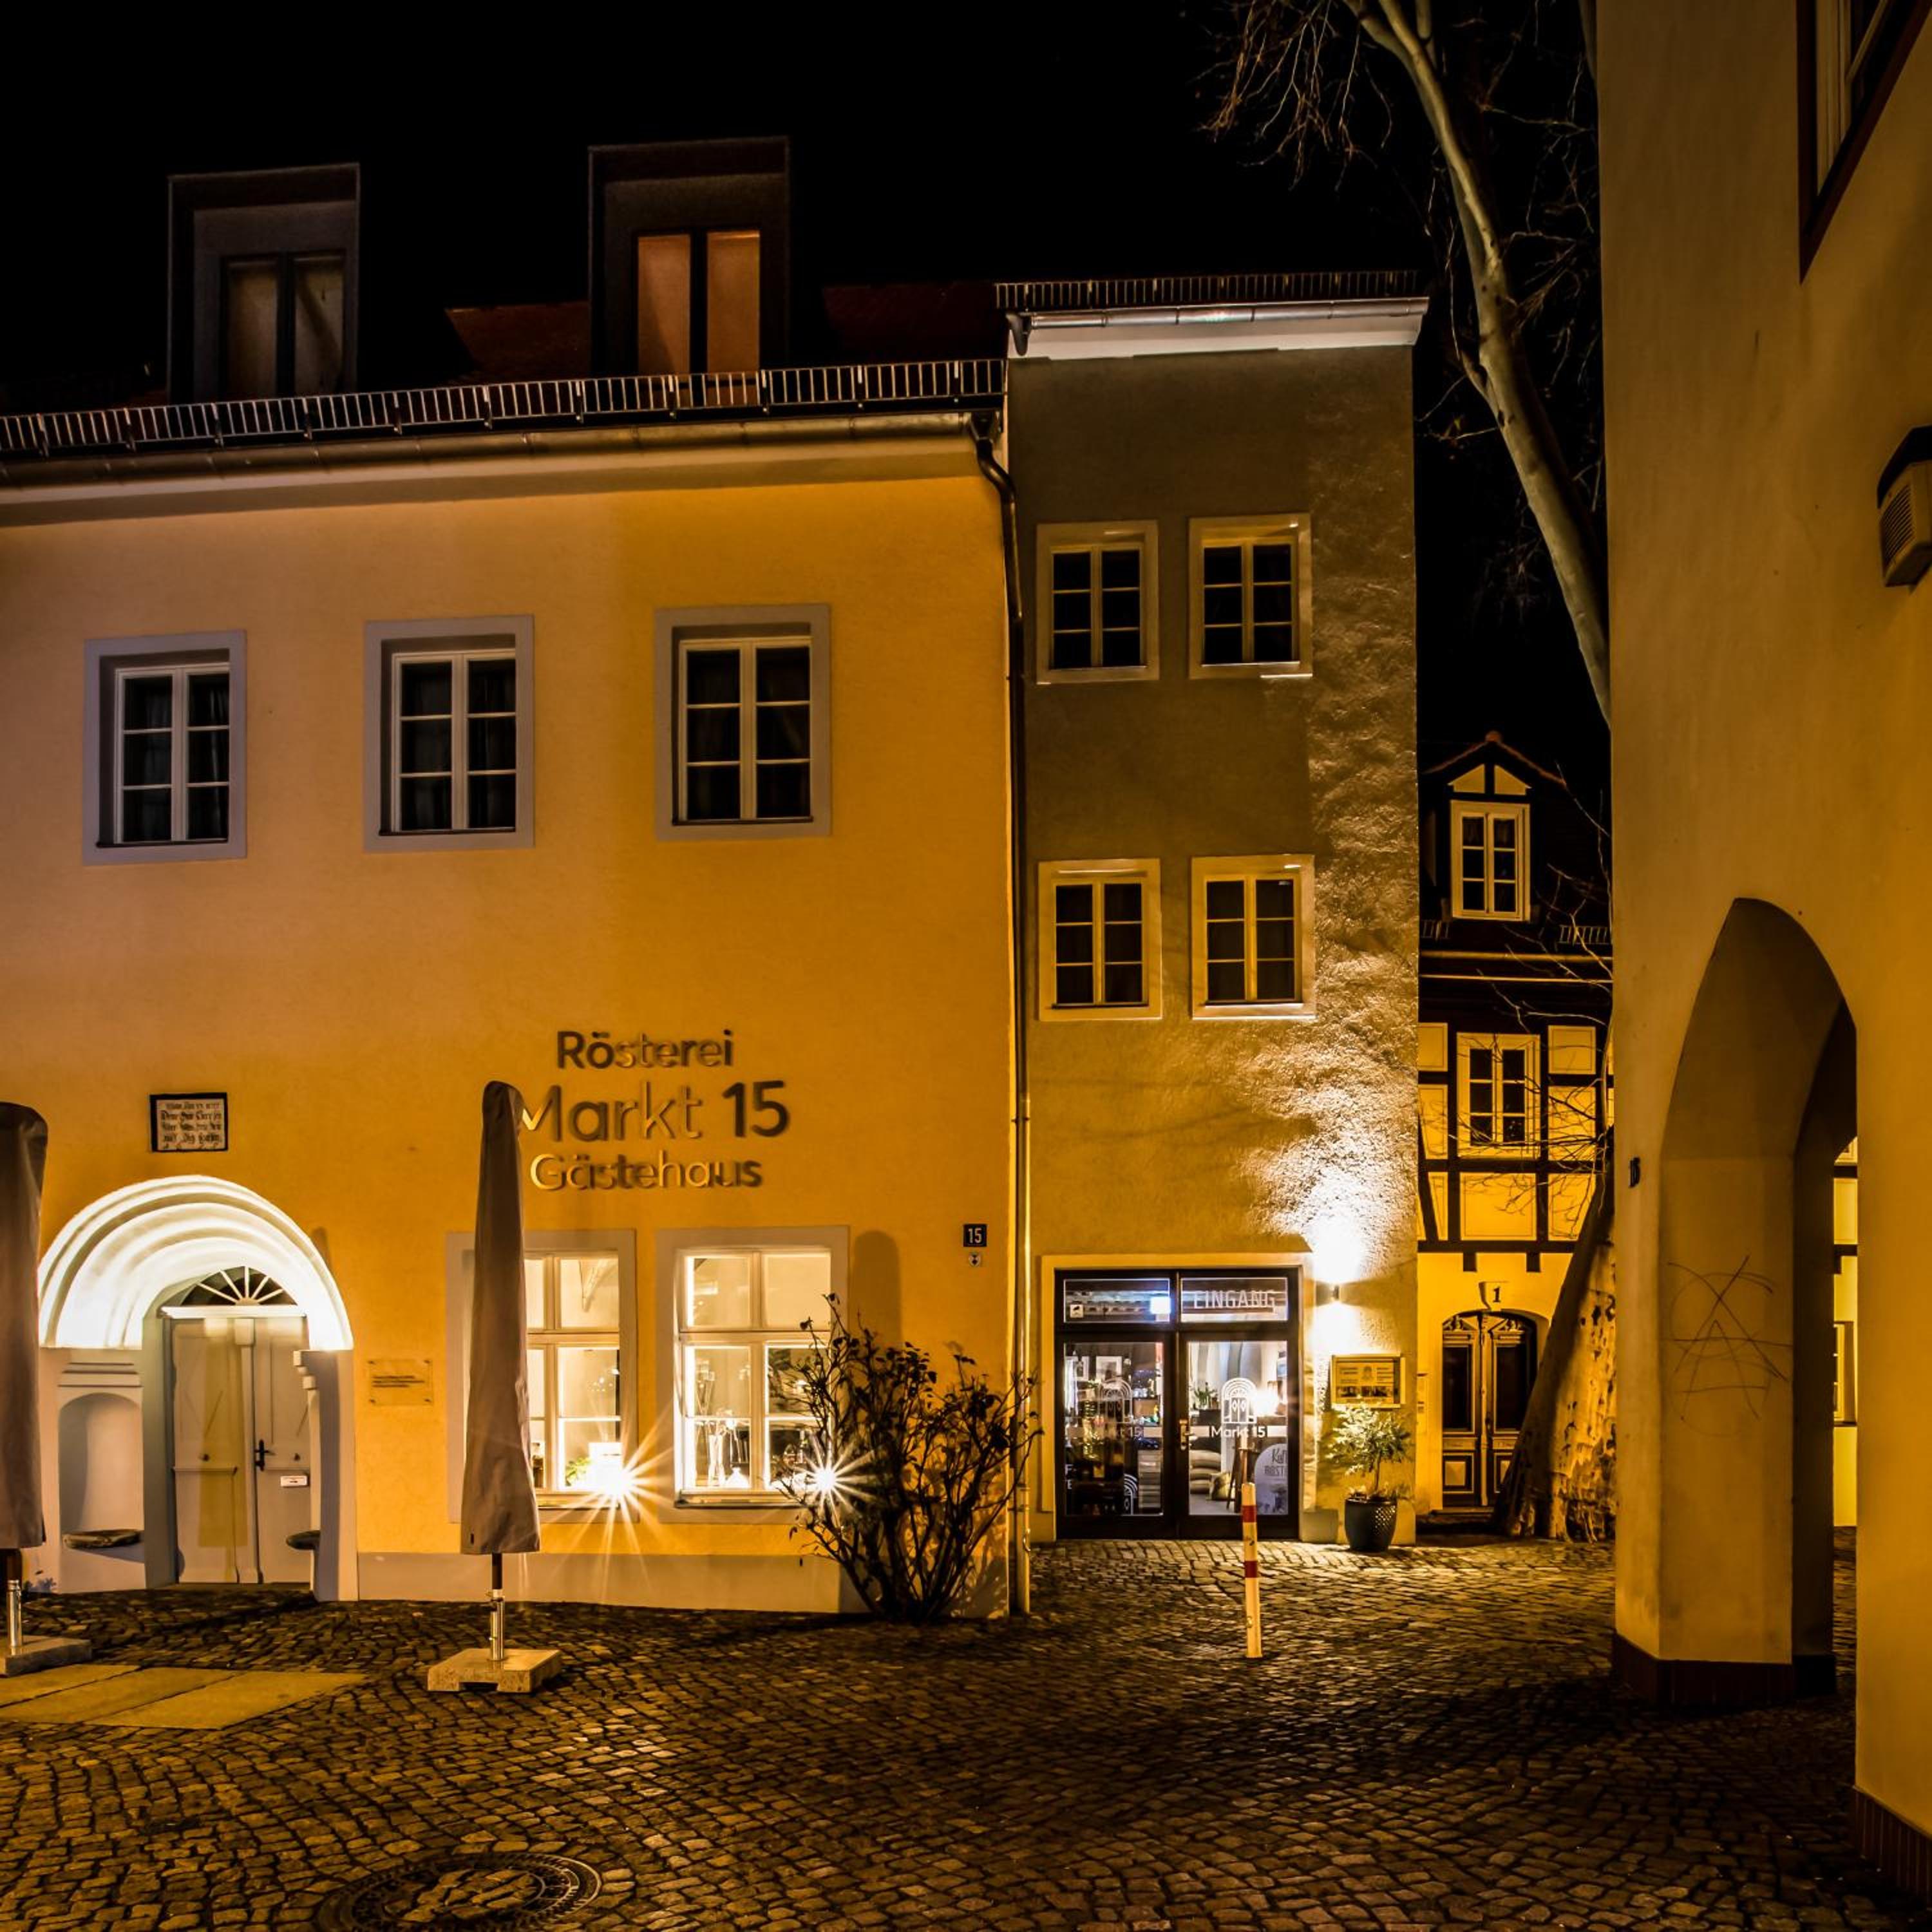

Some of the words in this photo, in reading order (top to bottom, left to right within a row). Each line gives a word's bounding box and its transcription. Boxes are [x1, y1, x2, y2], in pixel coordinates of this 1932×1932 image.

[556, 1029, 734, 1070] Rösterei
[517, 1081, 704, 1142] Markt
[721, 1079, 790, 1138] 15
[529, 1150, 763, 1191] Gästehaus
[968, 1227, 982, 1244] 15
[1193, 1289, 1275, 1309] EINGANG
[1493, 1285, 1501, 1303] 1
[1211, 1425, 1249, 1438] Markt
[1252, 1425, 1265, 1438] 15
